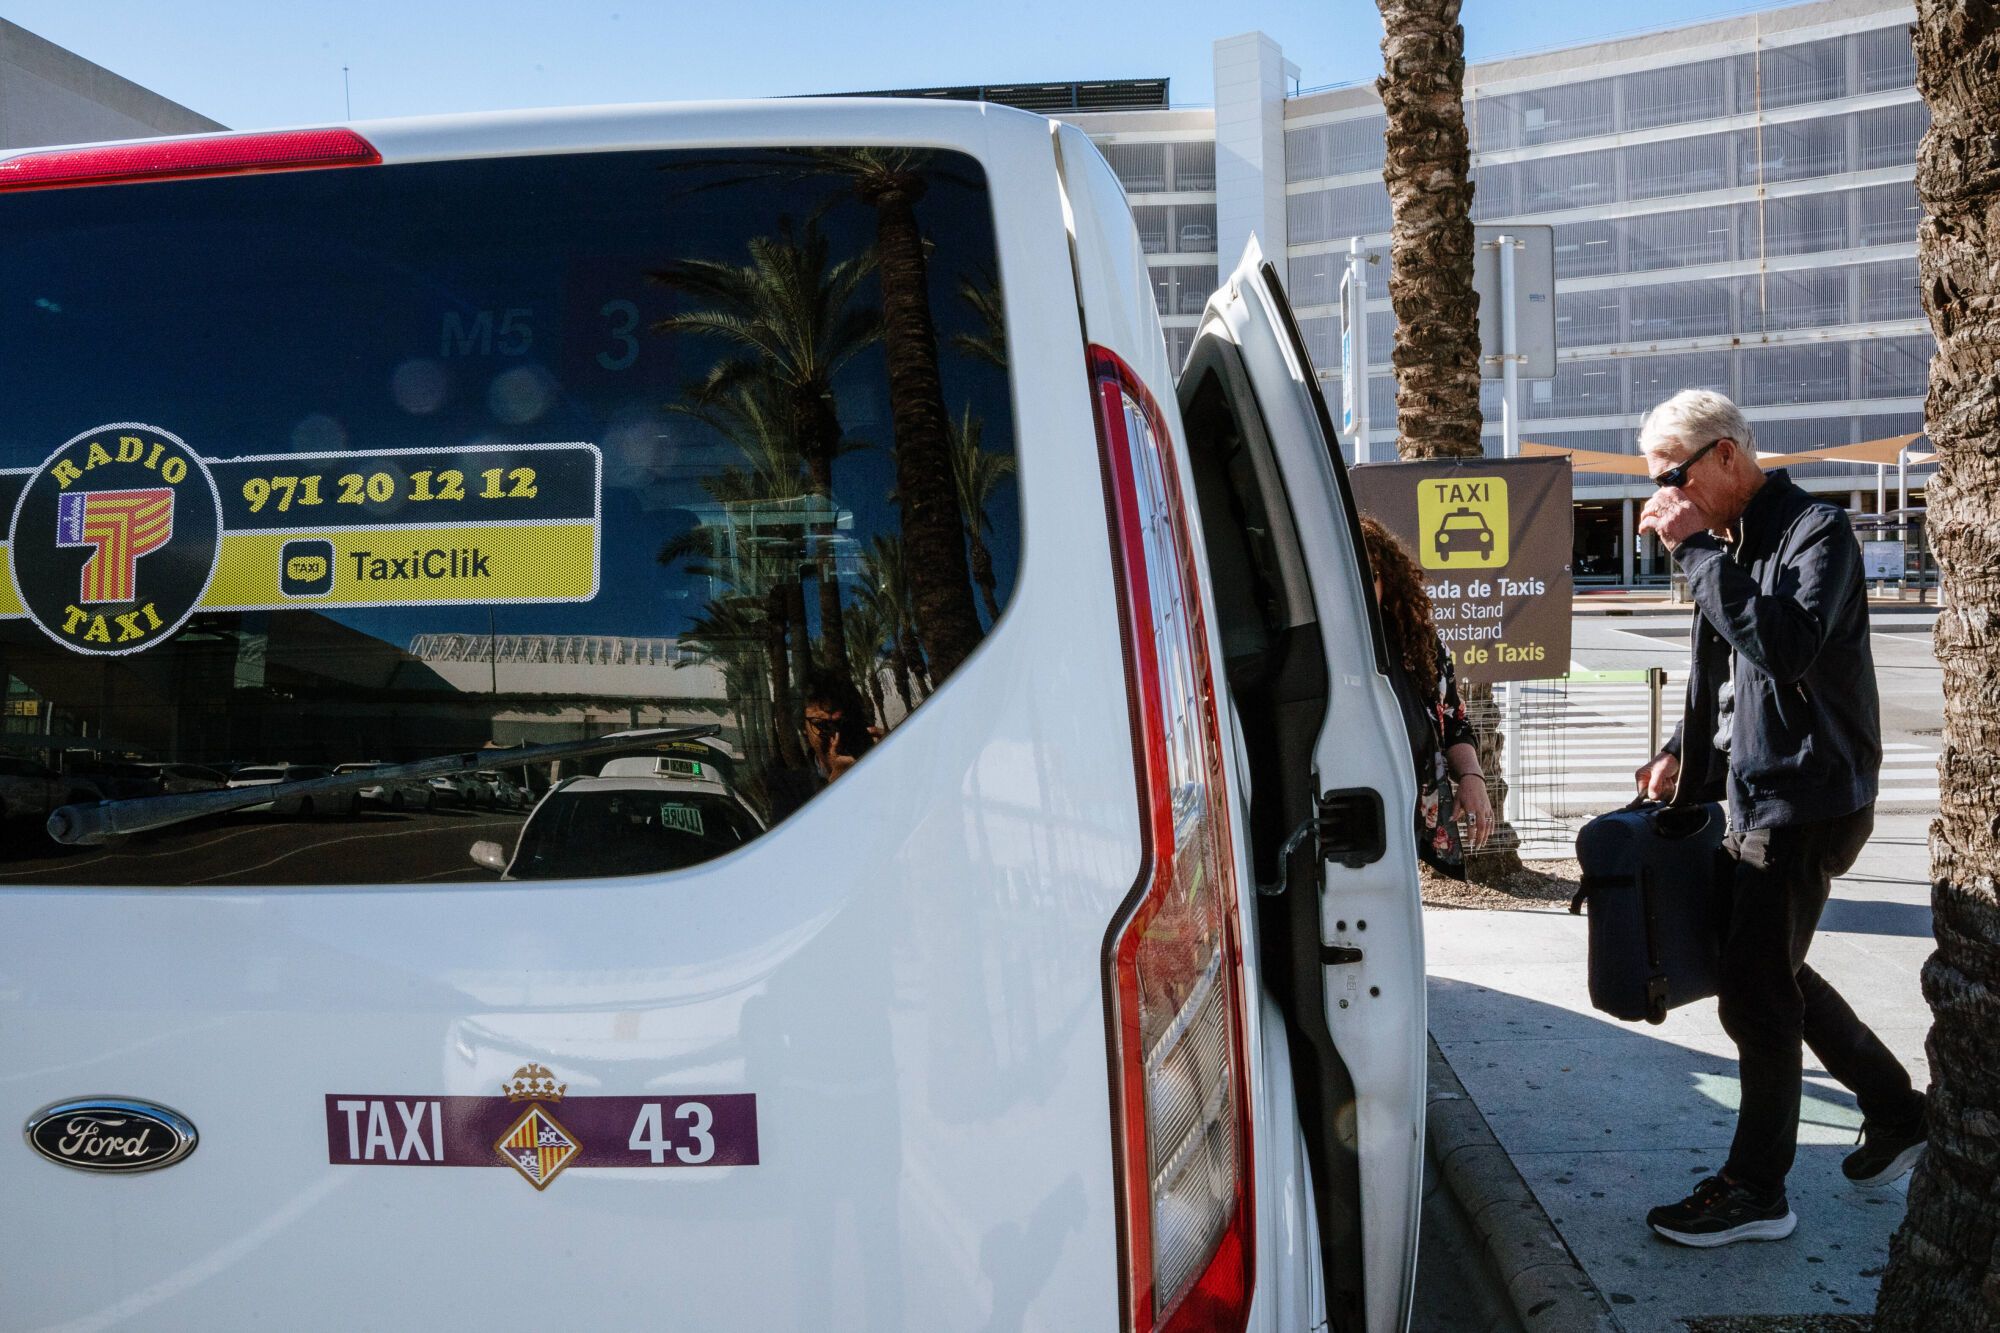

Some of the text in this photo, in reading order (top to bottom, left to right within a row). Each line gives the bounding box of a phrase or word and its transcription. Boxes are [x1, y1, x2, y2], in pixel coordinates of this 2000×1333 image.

[440, 307, 534, 358] M5
[595, 298, 640, 371] 3
[51, 436, 187, 489] RADIO
[243, 467, 538, 512] 971 20 12 12
[1435, 483, 1489, 503] TAXI
[294, 562, 319, 573] TAXI
[350, 548, 491, 580] TaxiClik
[1424, 577, 1545, 599] ada de Taxis
[62, 603, 164, 643] TAXI
[1461, 601, 1503, 619] Stand
[1436, 622, 1502, 641] axistand
[1463, 645, 1488, 665] de
[1495, 642, 1545, 662] Taxis
[58, 1116, 150, 1156] Ford
[337, 1100, 715, 1164] TAXI 43
